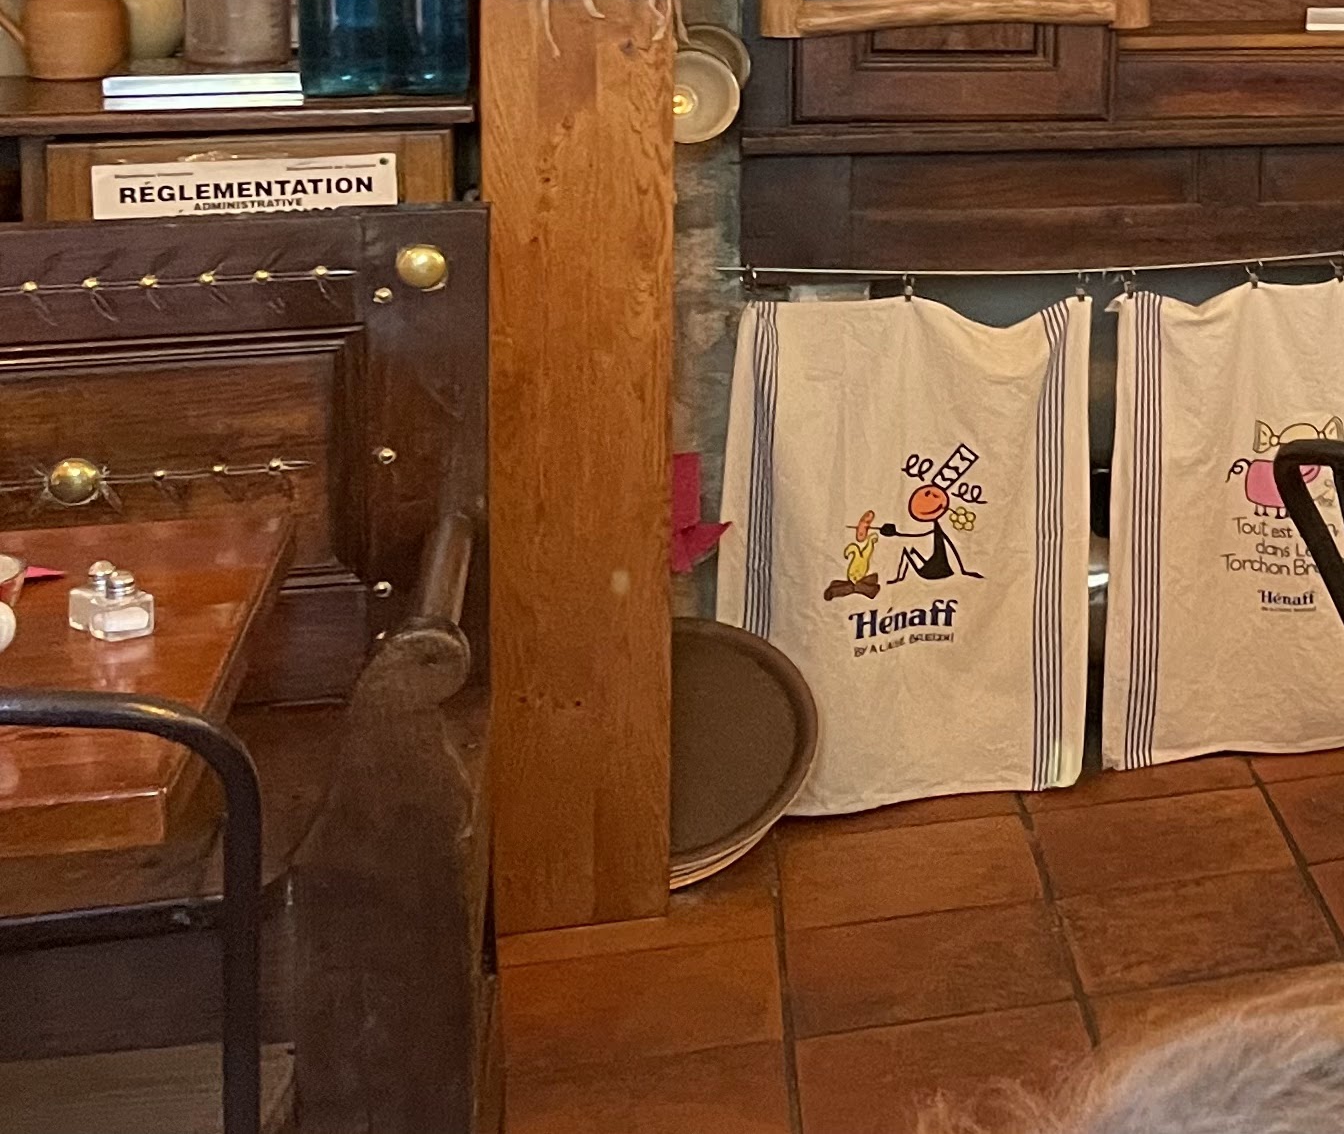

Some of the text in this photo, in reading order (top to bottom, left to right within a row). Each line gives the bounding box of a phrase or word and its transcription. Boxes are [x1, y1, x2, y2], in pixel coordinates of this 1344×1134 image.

[119, 176, 373, 204] RÉGLEMENTATION
[193, 197, 303, 212] ADMINISTRATIVE
[1232, 517, 1268, 536] Tout
[1272, 526, 1293, 538] est
[1256, 538, 1290, 558] dans
[1221, 553, 1290, 576] Torchon
[1257, 589, 1316, 606] Hénaff
[848, 599, 958, 640] Hénaff
